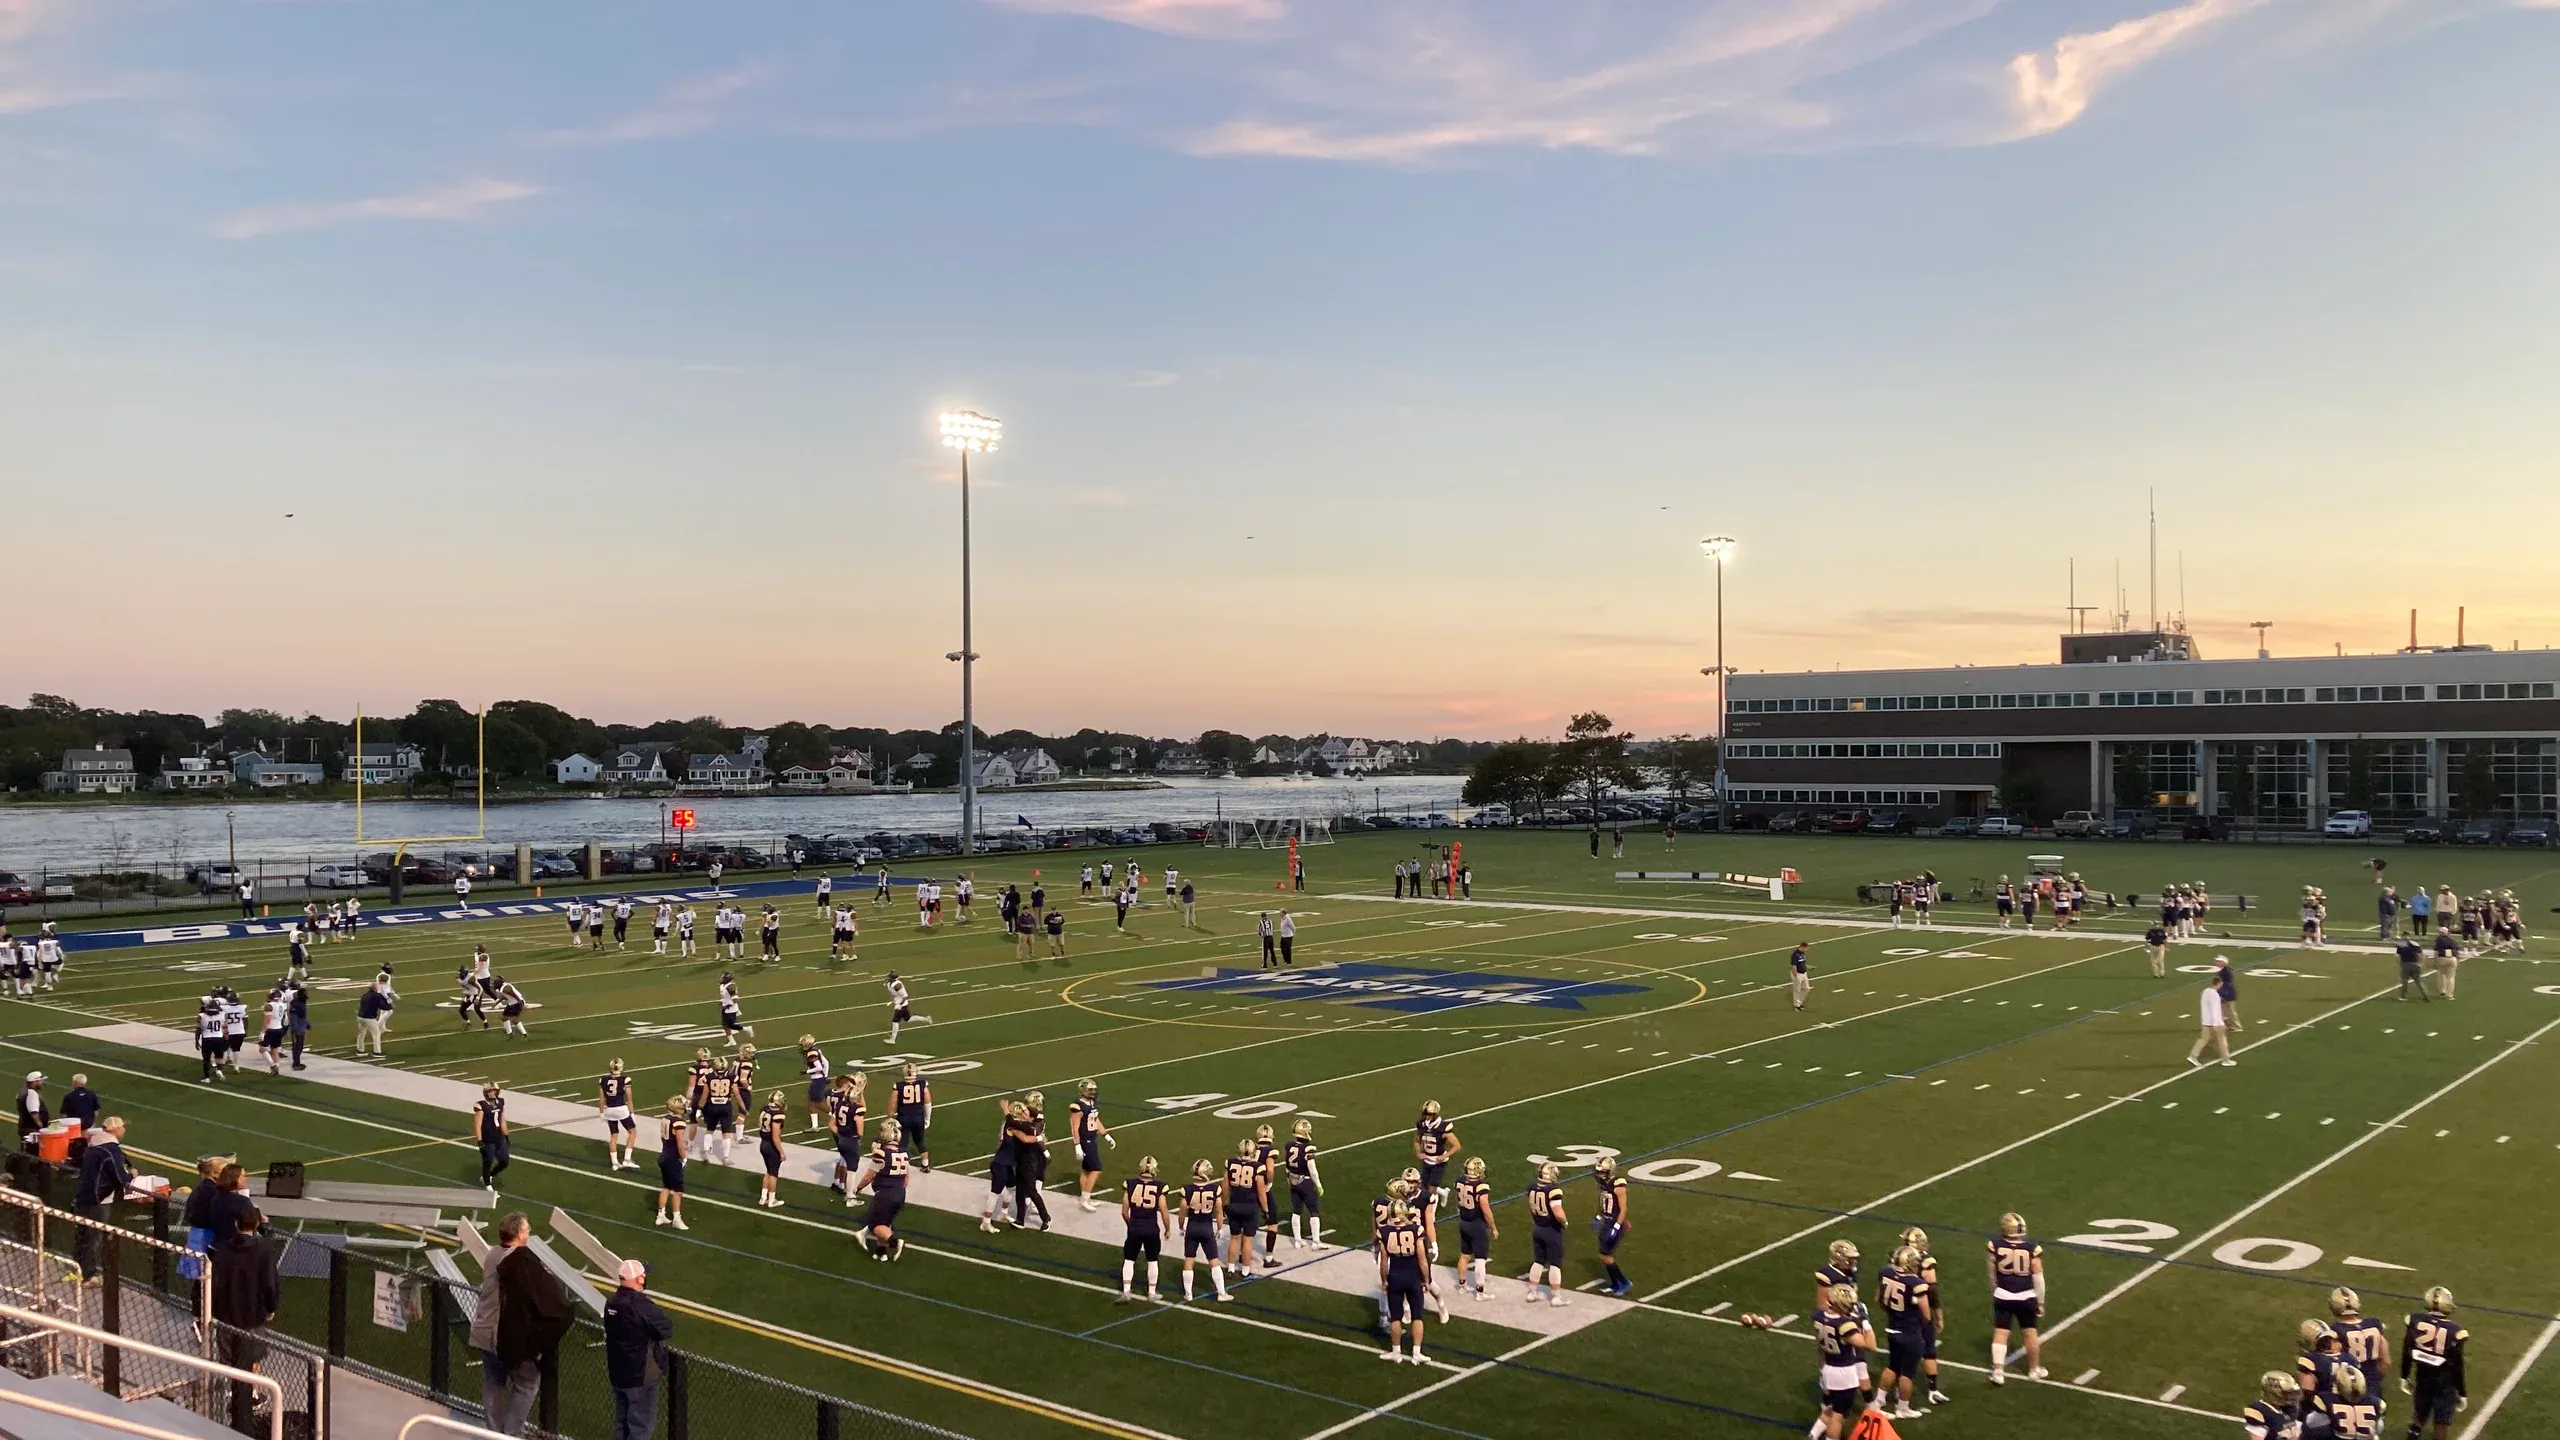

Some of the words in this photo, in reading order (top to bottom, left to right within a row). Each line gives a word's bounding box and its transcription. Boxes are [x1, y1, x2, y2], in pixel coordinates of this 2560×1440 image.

[675, 811, 693, 827] 25
[620, 908, 629, 916] 37
[1236, 971, 1556, 1005] MARITIME
[206, 1020, 221, 1034] 40
[226, 1012, 240, 1025] 55
[848, 1053, 985, 1075] 50
[606, 1079, 618, 1097] 3
[710, 1078, 731, 1098] 98
[903, 1085, 922, 1104] 91
[838, 1105, 850, 1127] 5
[1145, 1093, 1299, 1119] 40
[889, 1151, 909, 1176] 55
[1288, 1146, 1300, 1169] 2
[1526, 1144, 1722, 1182] 30
[1229, 1163, 1255, 1189] 38
[1130, 1183, 1159, 1209] 45
[1189, 1190, 1214, 1214] 46
[1455, 1182, 1475, 1210] 36
[1387, 1230, 1416, 1257] 48
[2057, 1218, 2323, 1271] 20
[1997, 1247, 2030, 1277] 20
[1881, 1276, 1906, 1312] 75
[2346, 1326, 2380, 1362] 87
[2415, 1321, 2448, 1355] 21
[2332, 1403, 2378, 1440] 35
